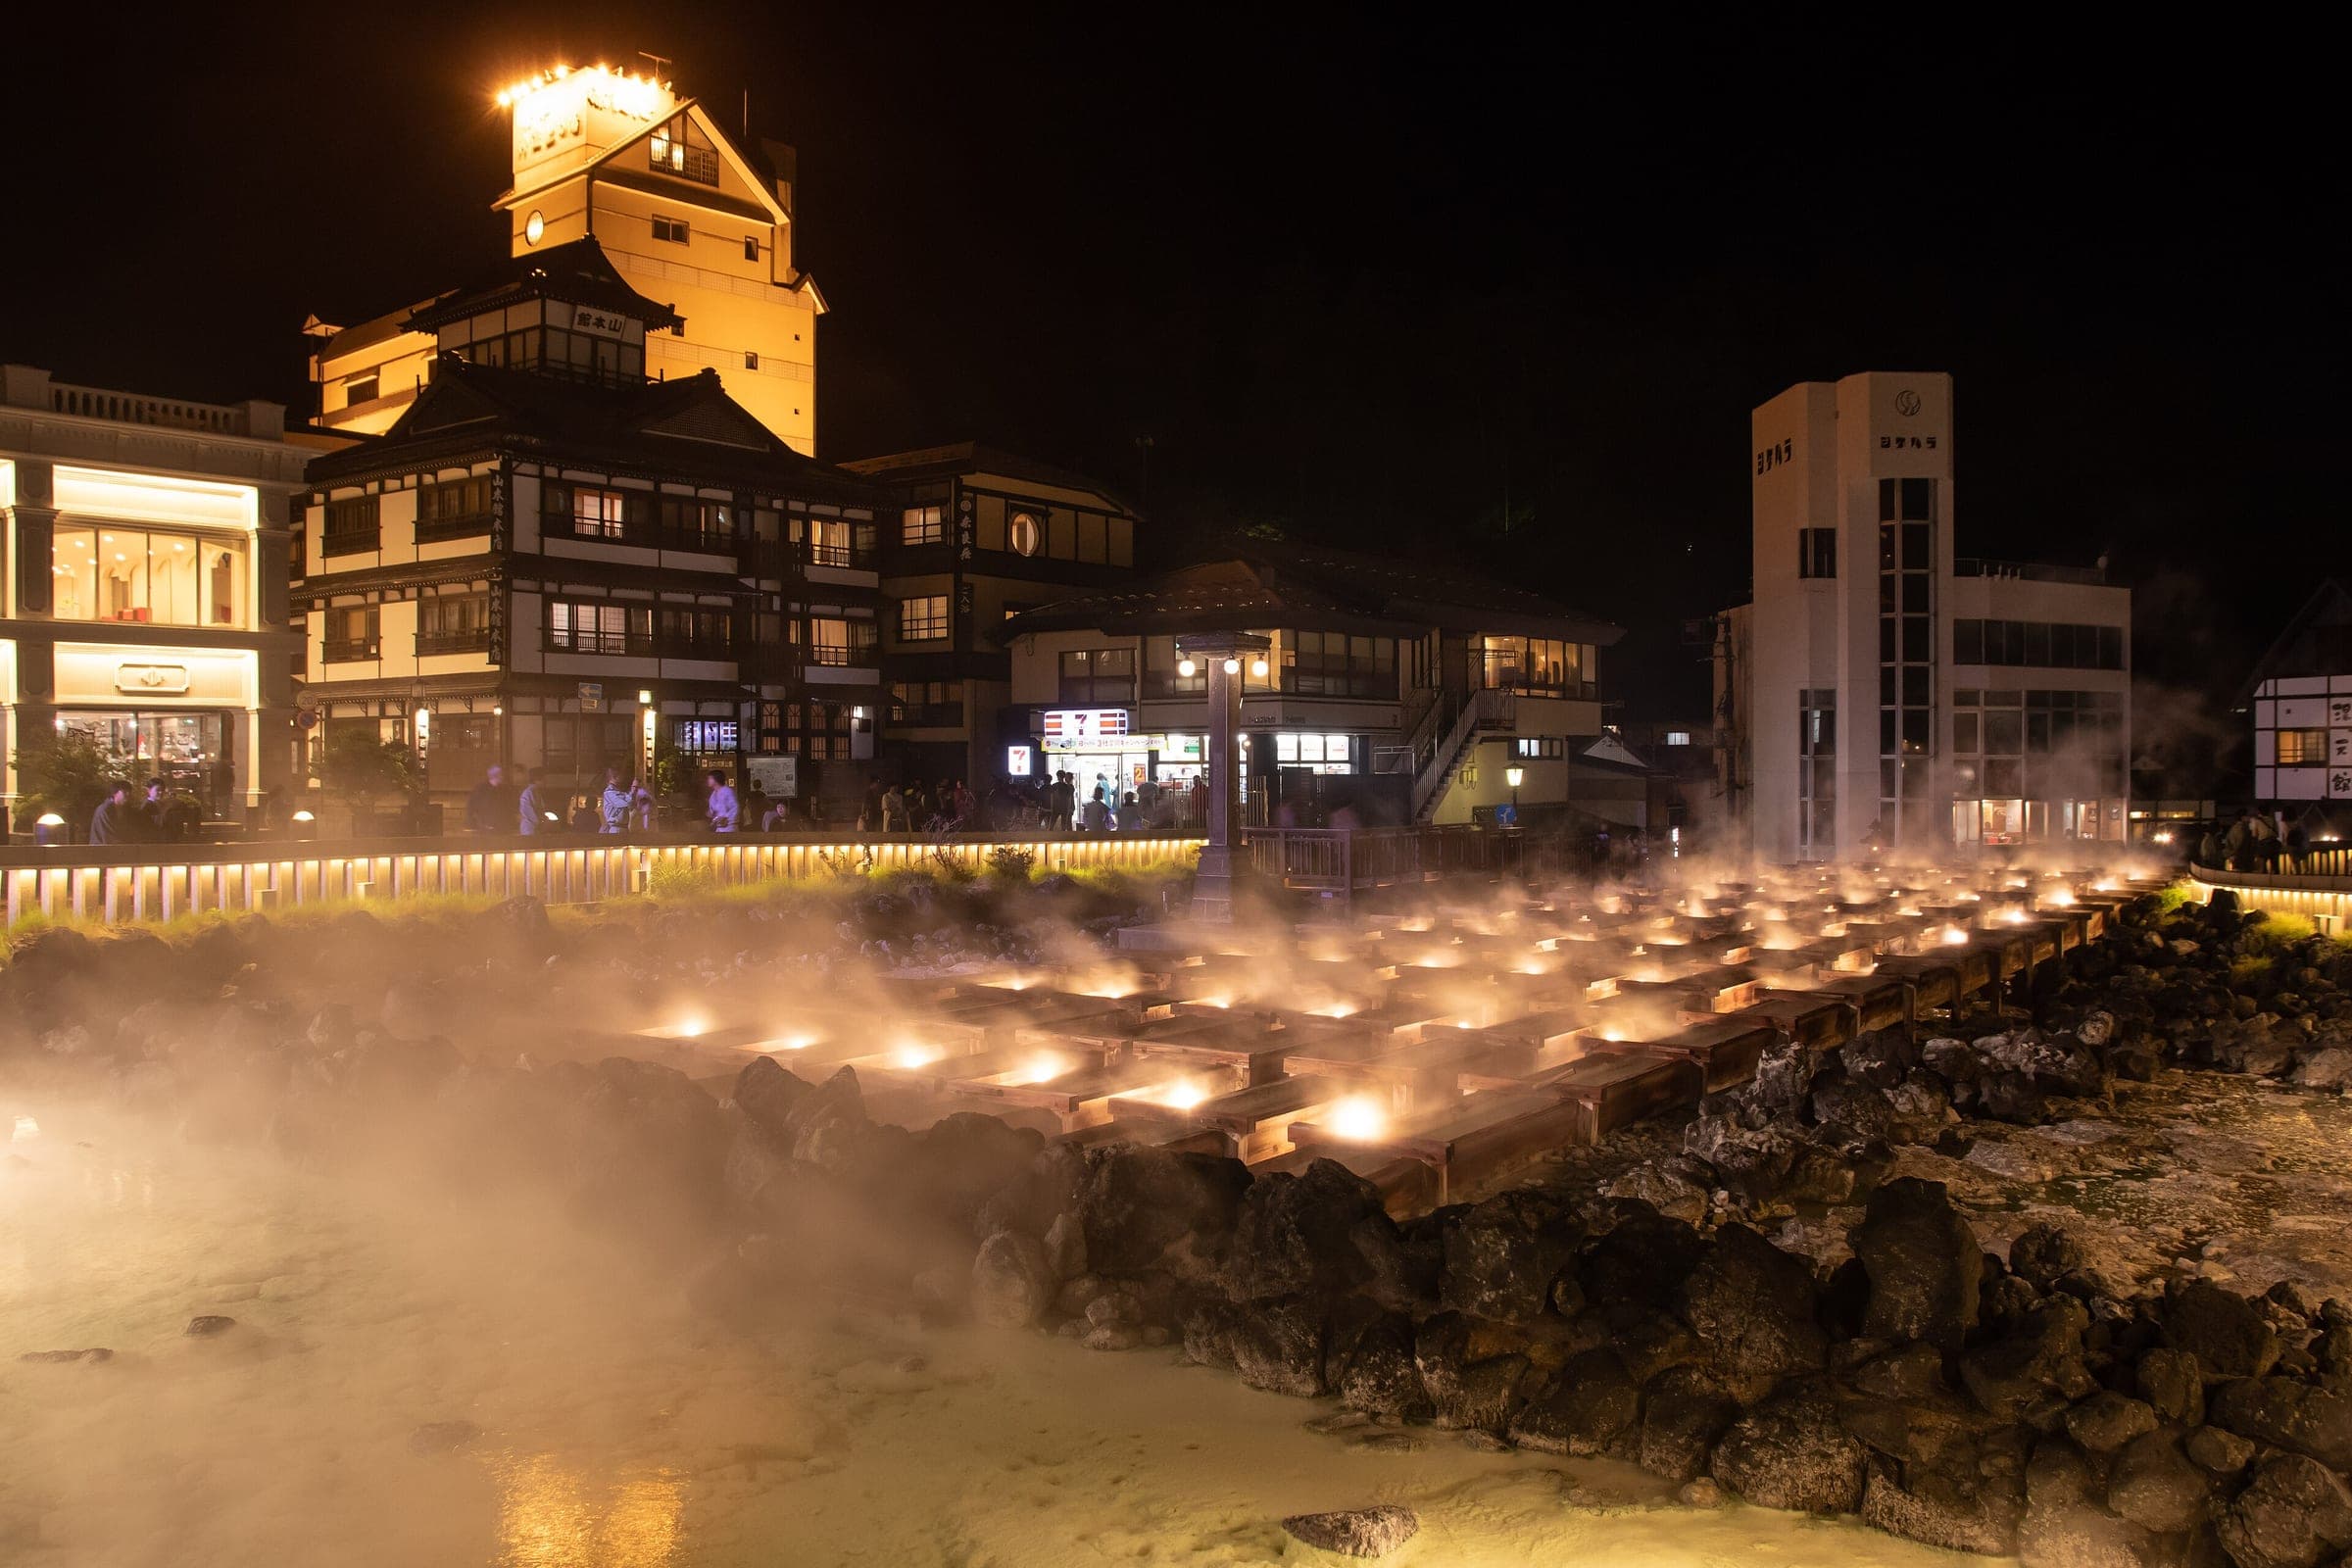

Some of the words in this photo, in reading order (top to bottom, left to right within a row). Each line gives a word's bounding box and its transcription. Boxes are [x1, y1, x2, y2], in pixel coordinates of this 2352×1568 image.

[576, 312, 623, 333] 山本館
[301, 696, 314, 706] 20
